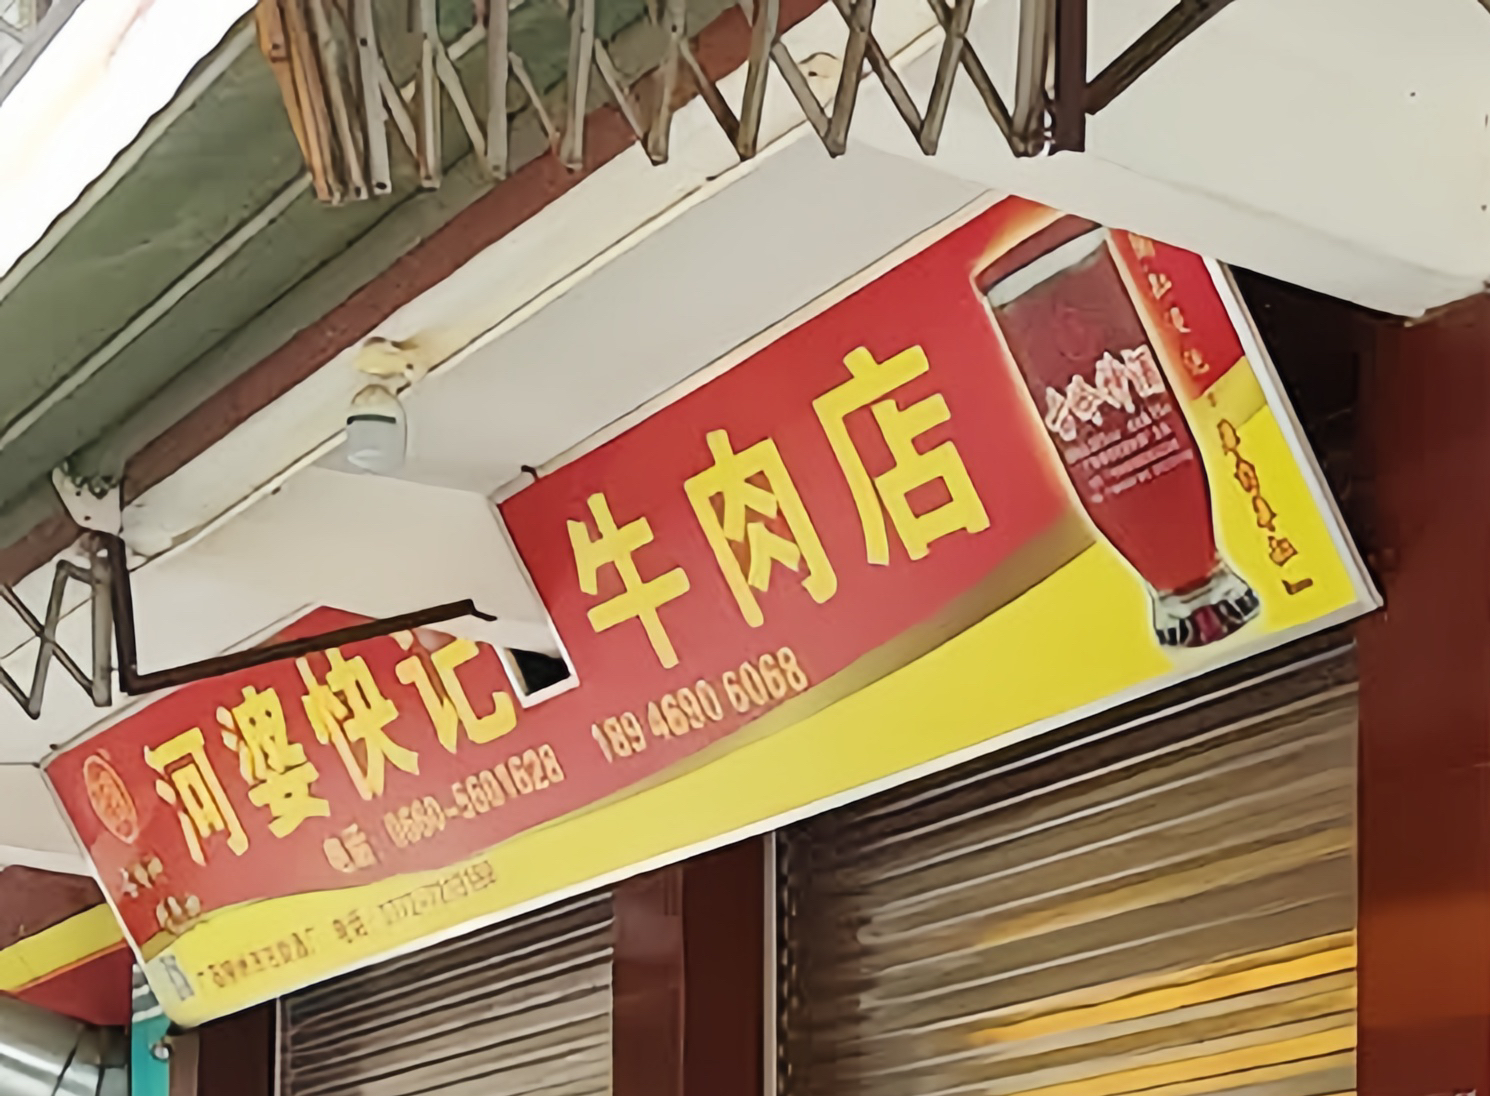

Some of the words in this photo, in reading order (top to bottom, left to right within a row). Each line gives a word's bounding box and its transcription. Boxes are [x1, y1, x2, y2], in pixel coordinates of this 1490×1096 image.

[566, 343, 991, 671] 牛肉店
[143, 628, 518, 867] 河婆快记
